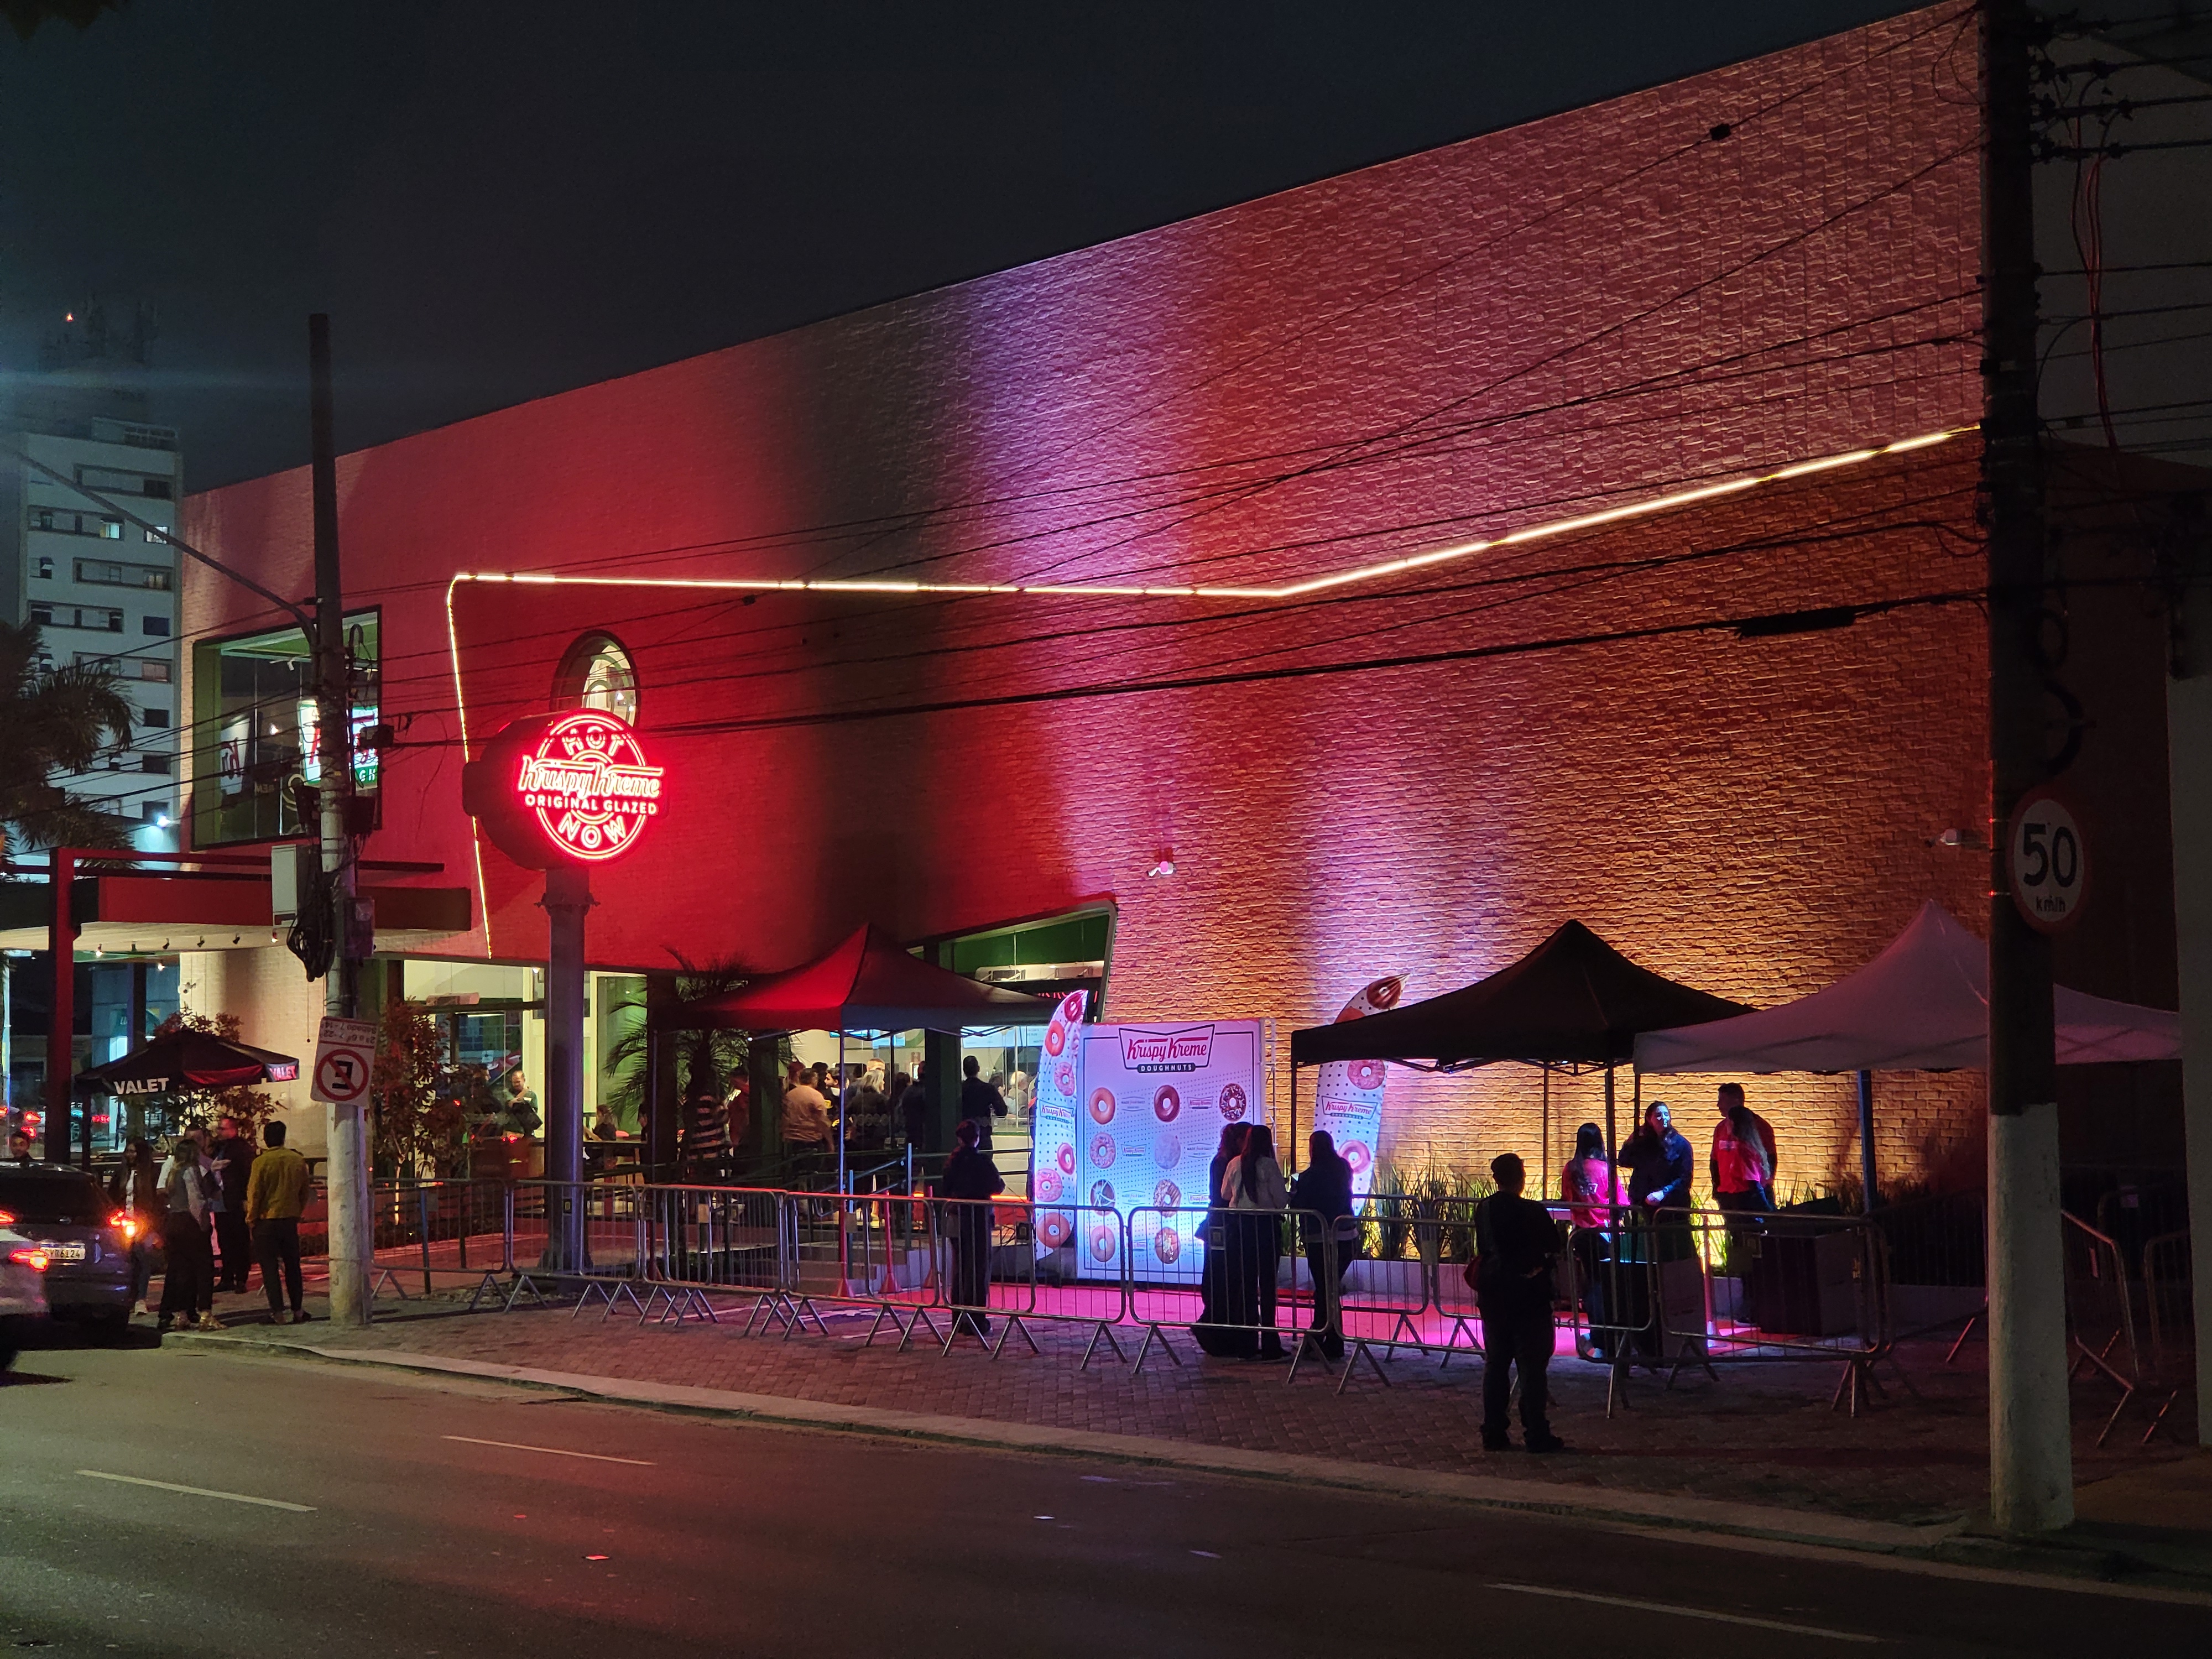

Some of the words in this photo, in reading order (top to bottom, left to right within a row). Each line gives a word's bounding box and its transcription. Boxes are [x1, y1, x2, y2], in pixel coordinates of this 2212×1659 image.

[561, 726, 624, 757] HOT
[518, 754, 596, 800] Krispy
[592, 761, 664, 798] Kreme
[525, 794, 598, 811] ORIGINAL
[603, 800, 659, 816] GLAZED
[558, 812, 627, 849] NOW
[2023, 823, 2077, 888] 50
[1127, 1038, 1168, 1062] Krispy
[1167, 1036, 1209, 1058] Kreme
[113, 1077, 170, 1094] VALET
[269, 1065, 296, 1081] VALET
